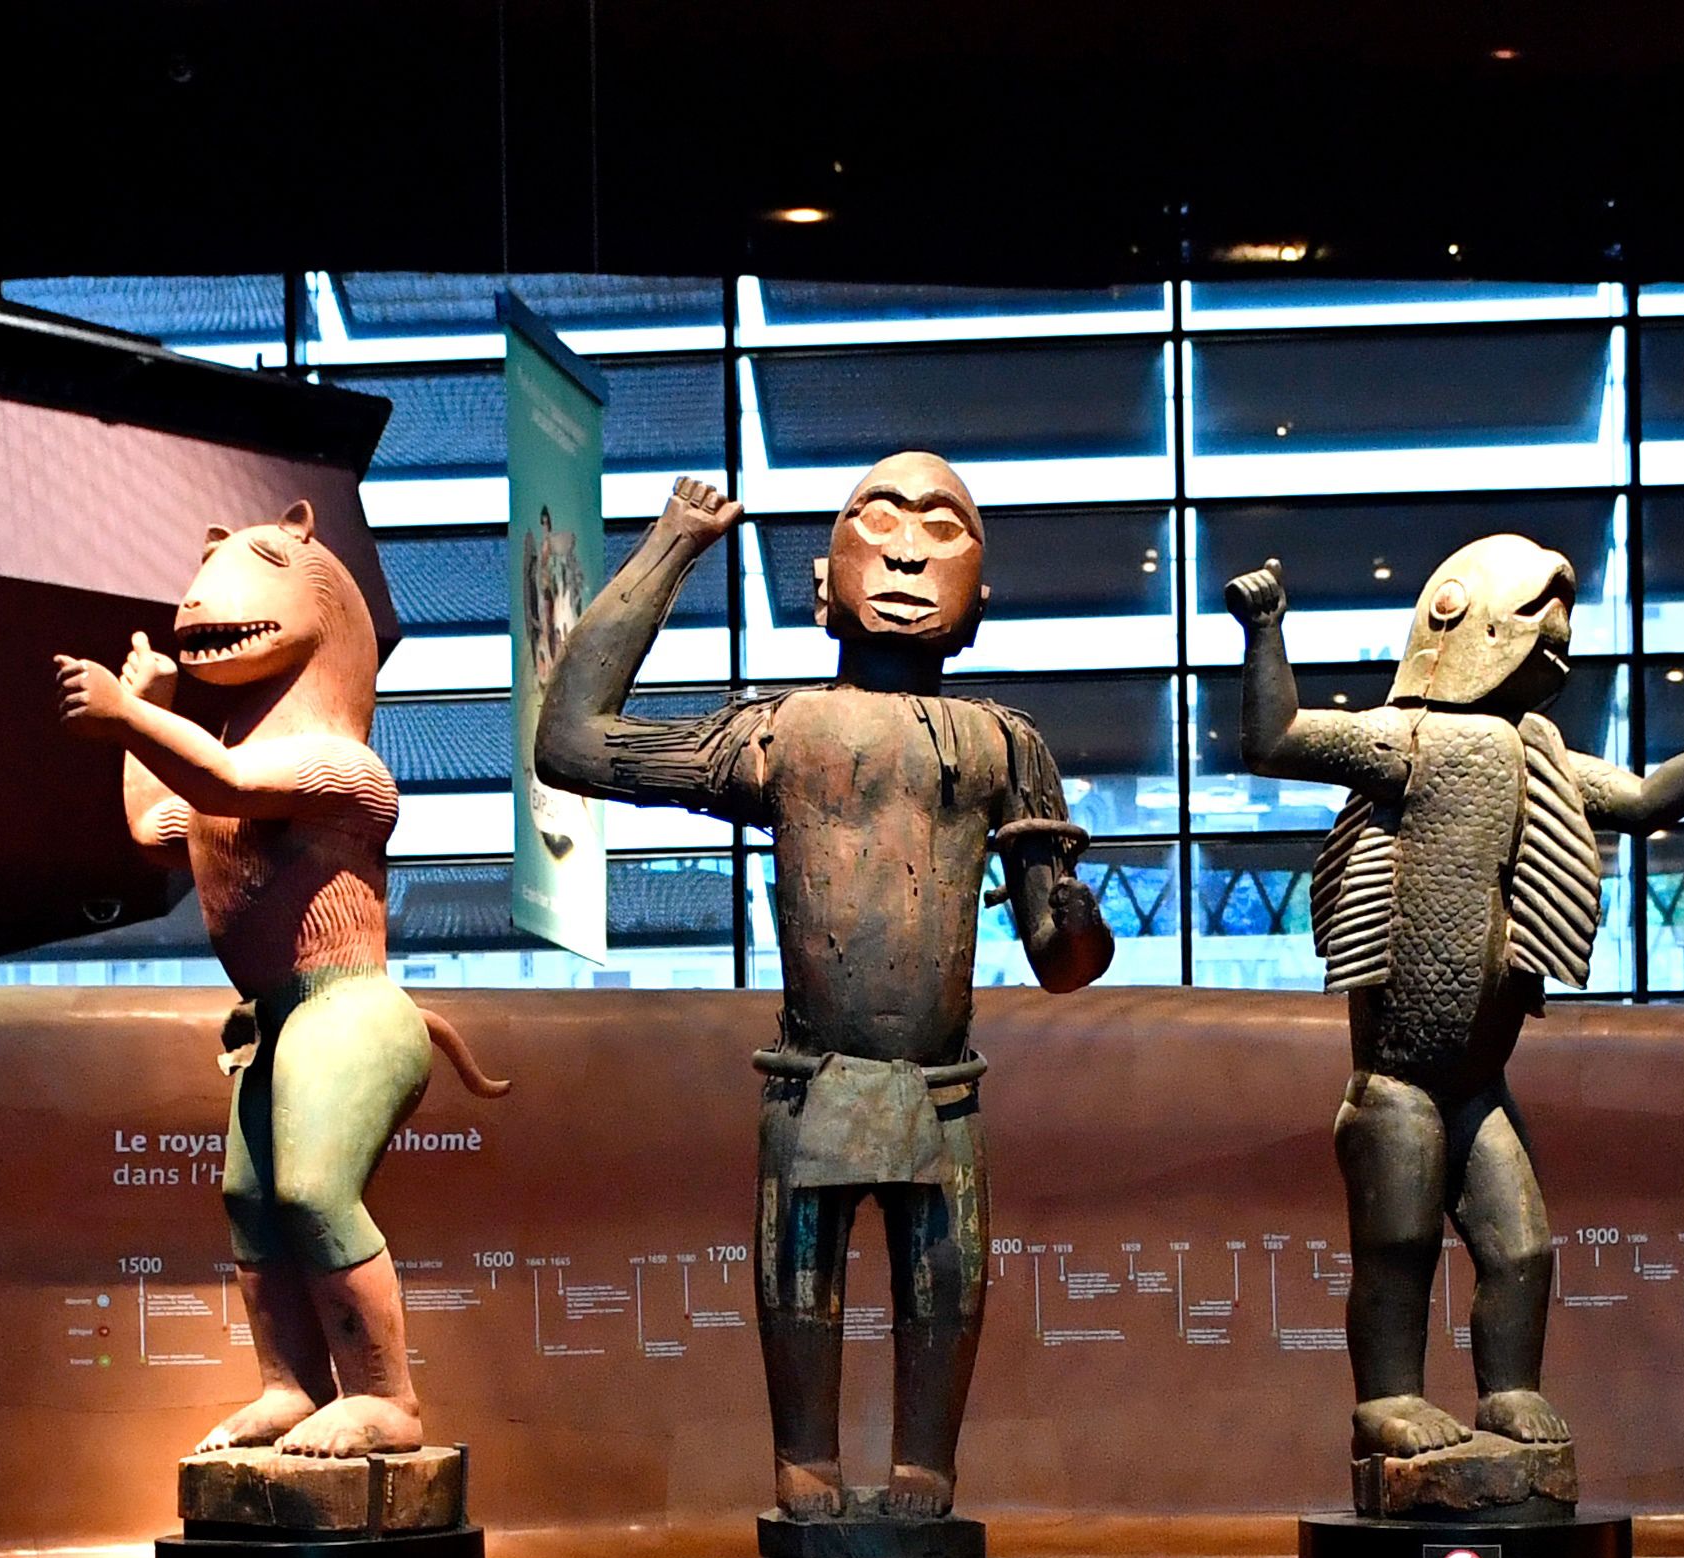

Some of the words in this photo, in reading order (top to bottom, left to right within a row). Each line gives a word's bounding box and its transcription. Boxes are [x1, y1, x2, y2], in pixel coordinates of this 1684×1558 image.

[114, 1130, 147, 1153] Le
[158, 1134, 230, 1158] roya
[112, 1163, 180, 1186] dans
[191, 1163, 225, 1185] l'H
[1552, 1235, 1569, 1245] 897
[1575, 1228, 1619, 1245] 1900
[706, 1245, 747, 1262] 1700
[991, 1238, 1023, 1255] 800
[118, 1257, 163, 1274] 1500
[473, 1251, 515, 1268] 1600
